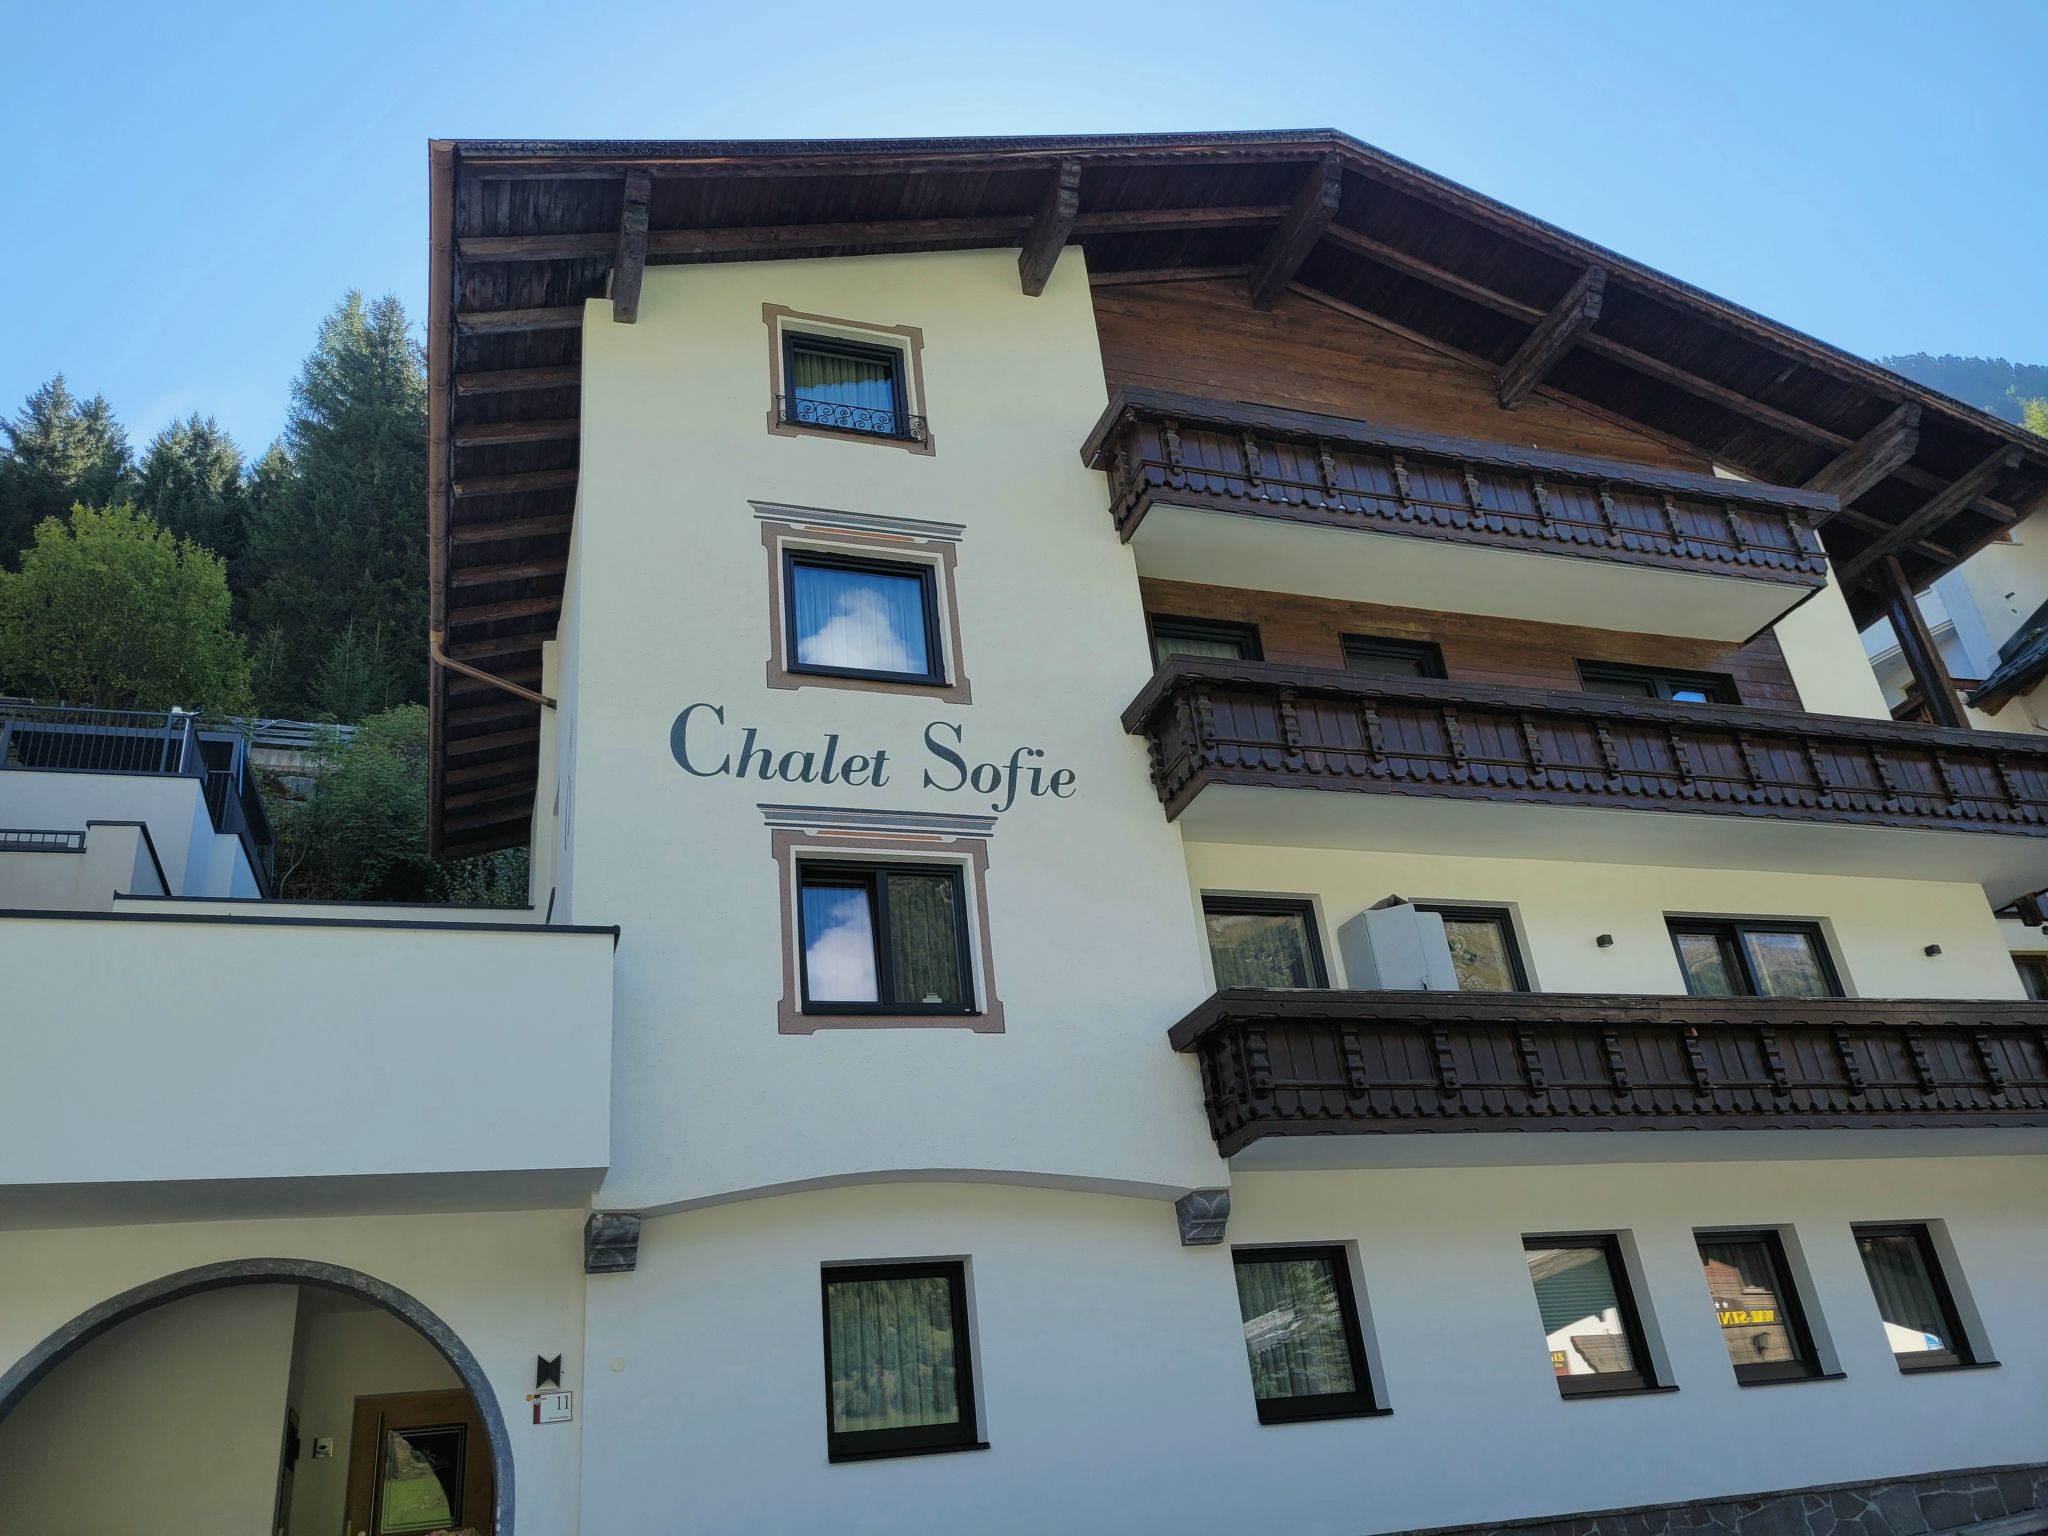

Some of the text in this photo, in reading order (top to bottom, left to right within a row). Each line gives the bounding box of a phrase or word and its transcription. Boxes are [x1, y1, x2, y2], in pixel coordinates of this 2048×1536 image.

[670, 703, 1077, 812] Chalet Sofie
[556, 1395, 569, 1410] 11
